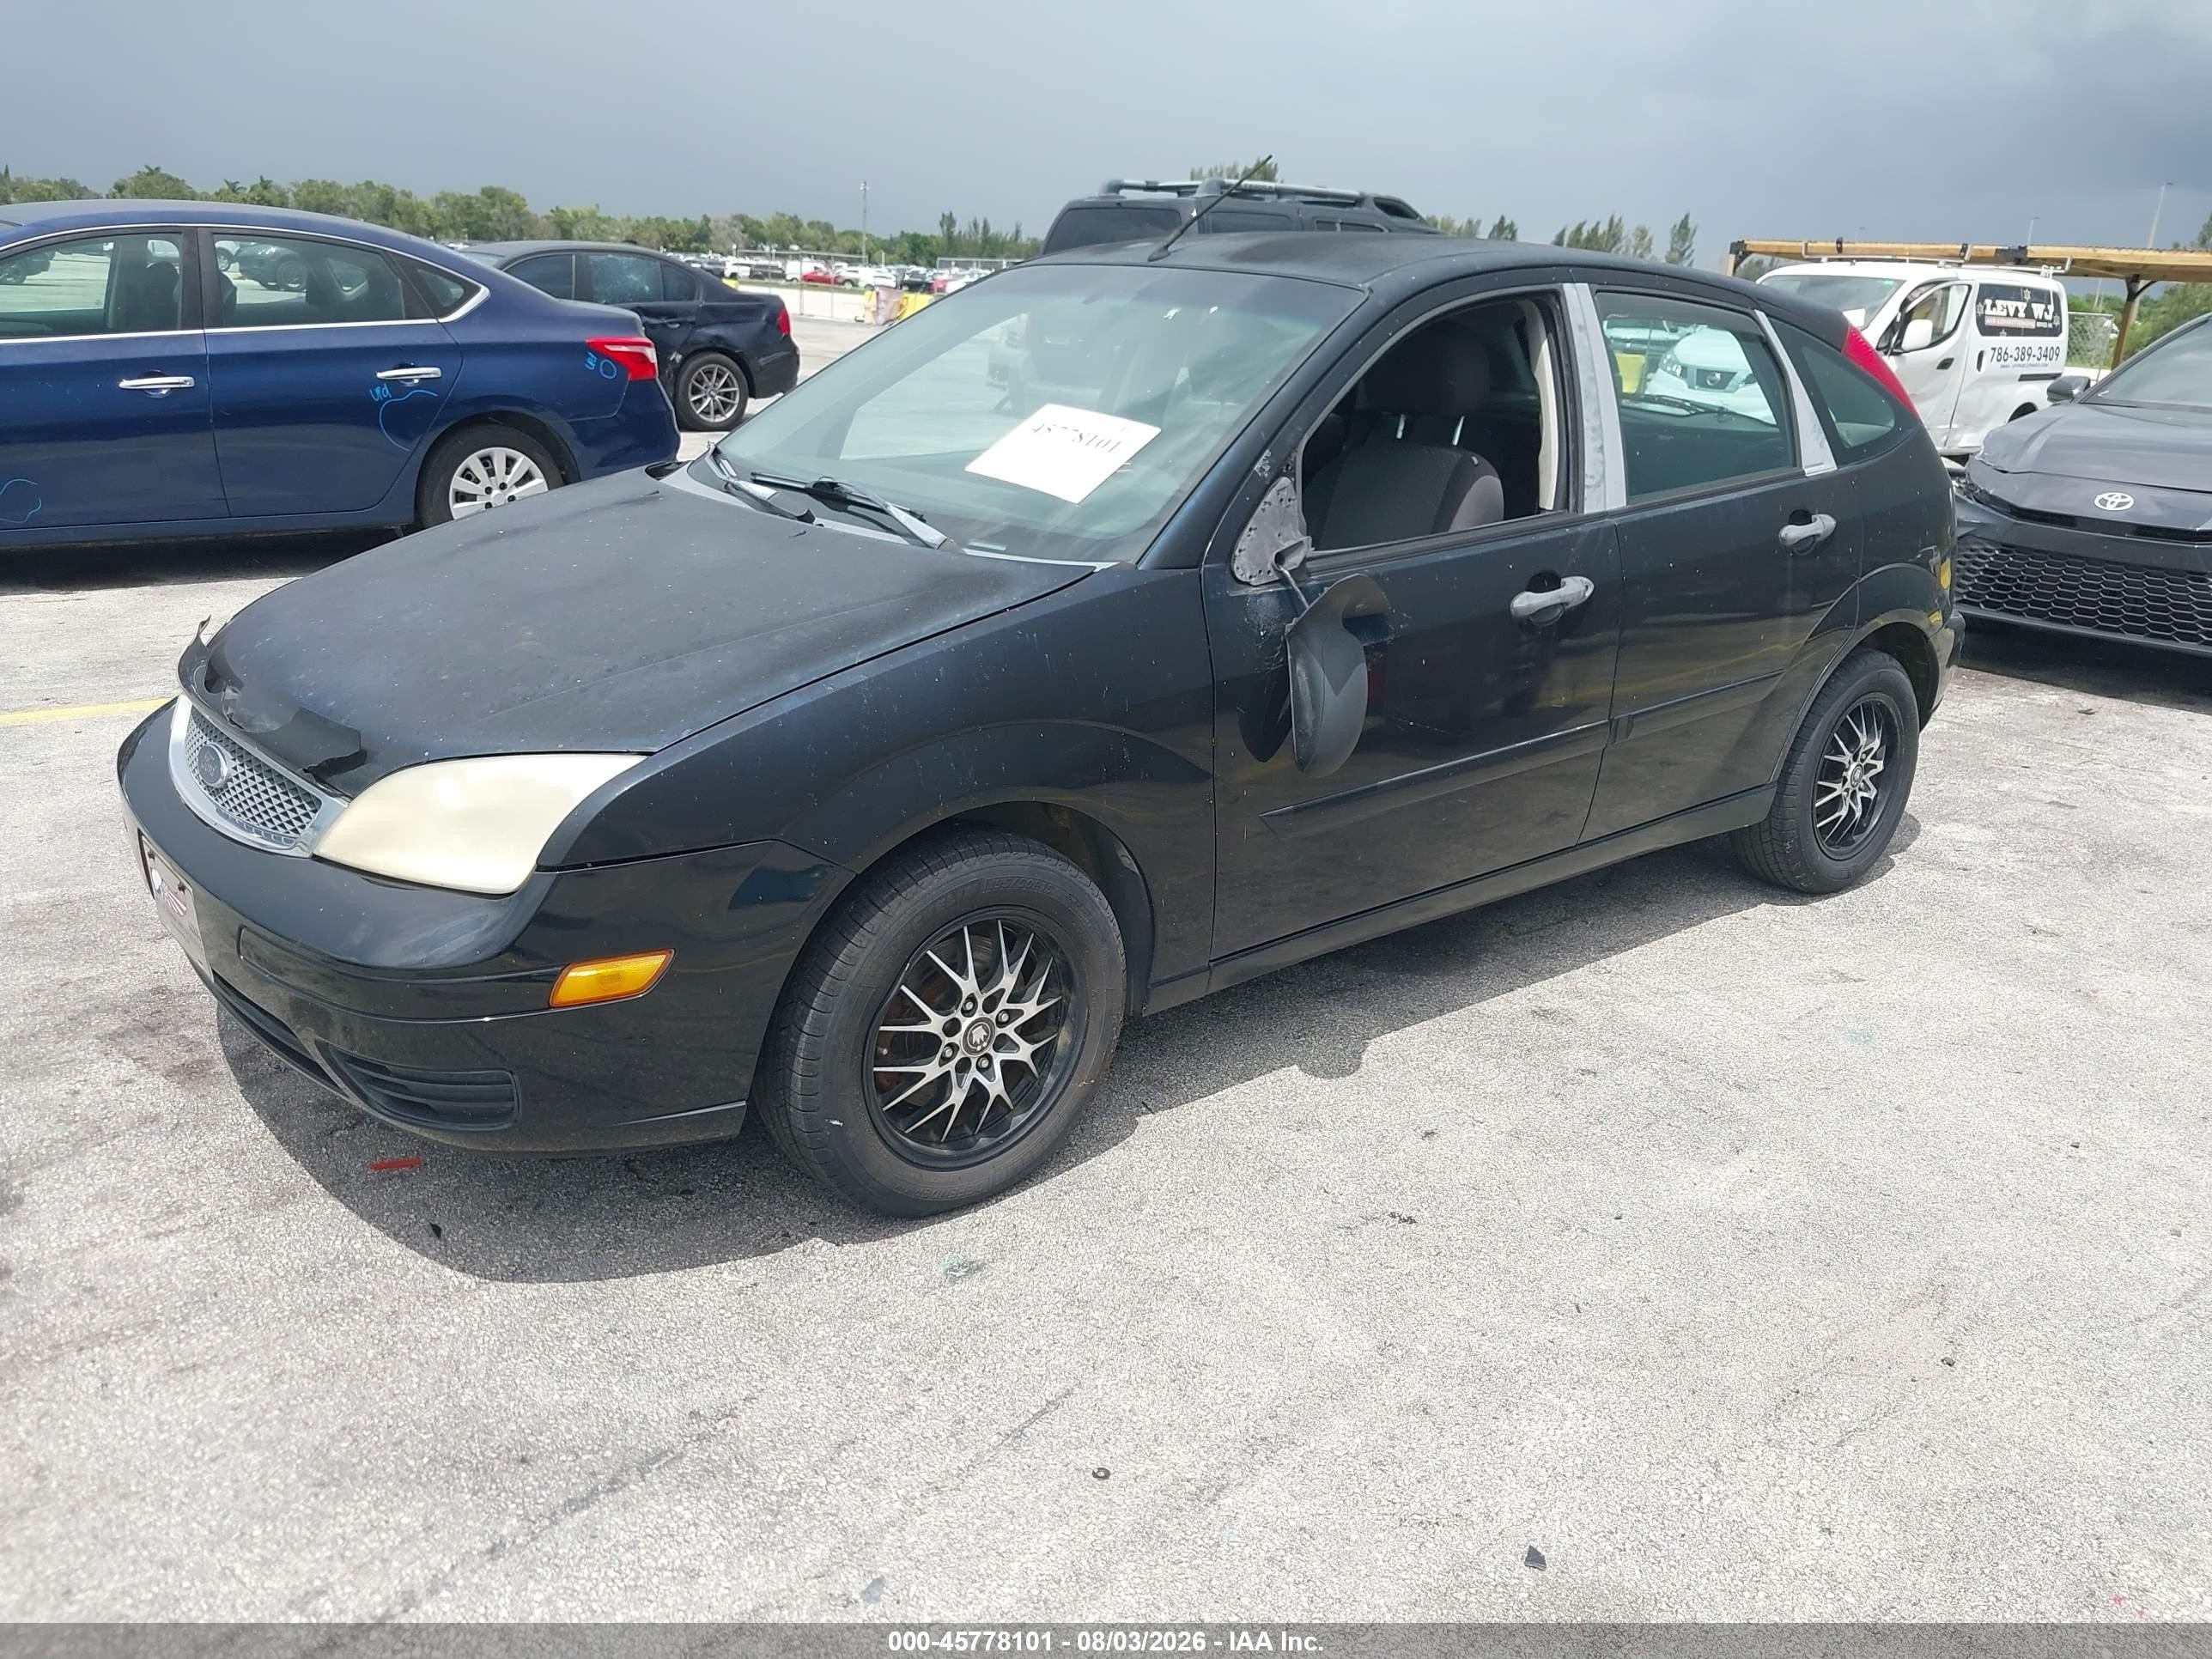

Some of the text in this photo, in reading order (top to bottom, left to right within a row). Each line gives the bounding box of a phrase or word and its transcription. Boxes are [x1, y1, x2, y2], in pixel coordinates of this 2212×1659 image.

[1984, 299, 2054, 320] LEVY WJ
[1990, 347, 2060, 362] 786-389-3409
